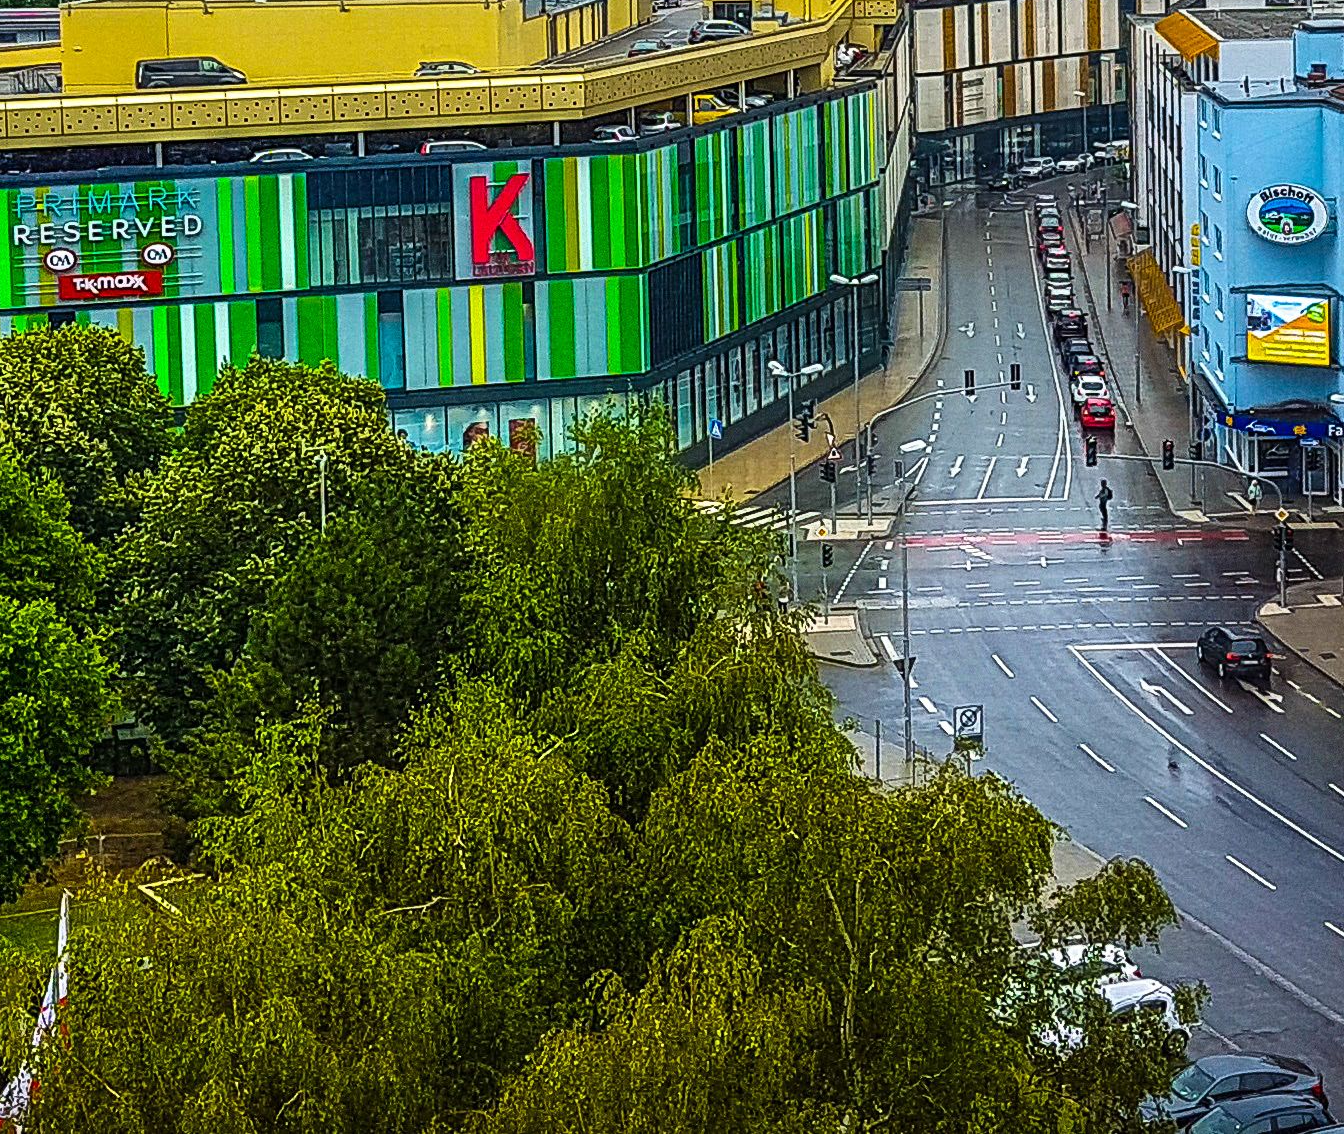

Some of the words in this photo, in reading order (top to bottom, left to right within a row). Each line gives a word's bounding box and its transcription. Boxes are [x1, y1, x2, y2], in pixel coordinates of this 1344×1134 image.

[16, 186, 197, 218] PRIMARK
[13, 214, 203, 245] RESERVED
[469, 173, 534, 264] K
